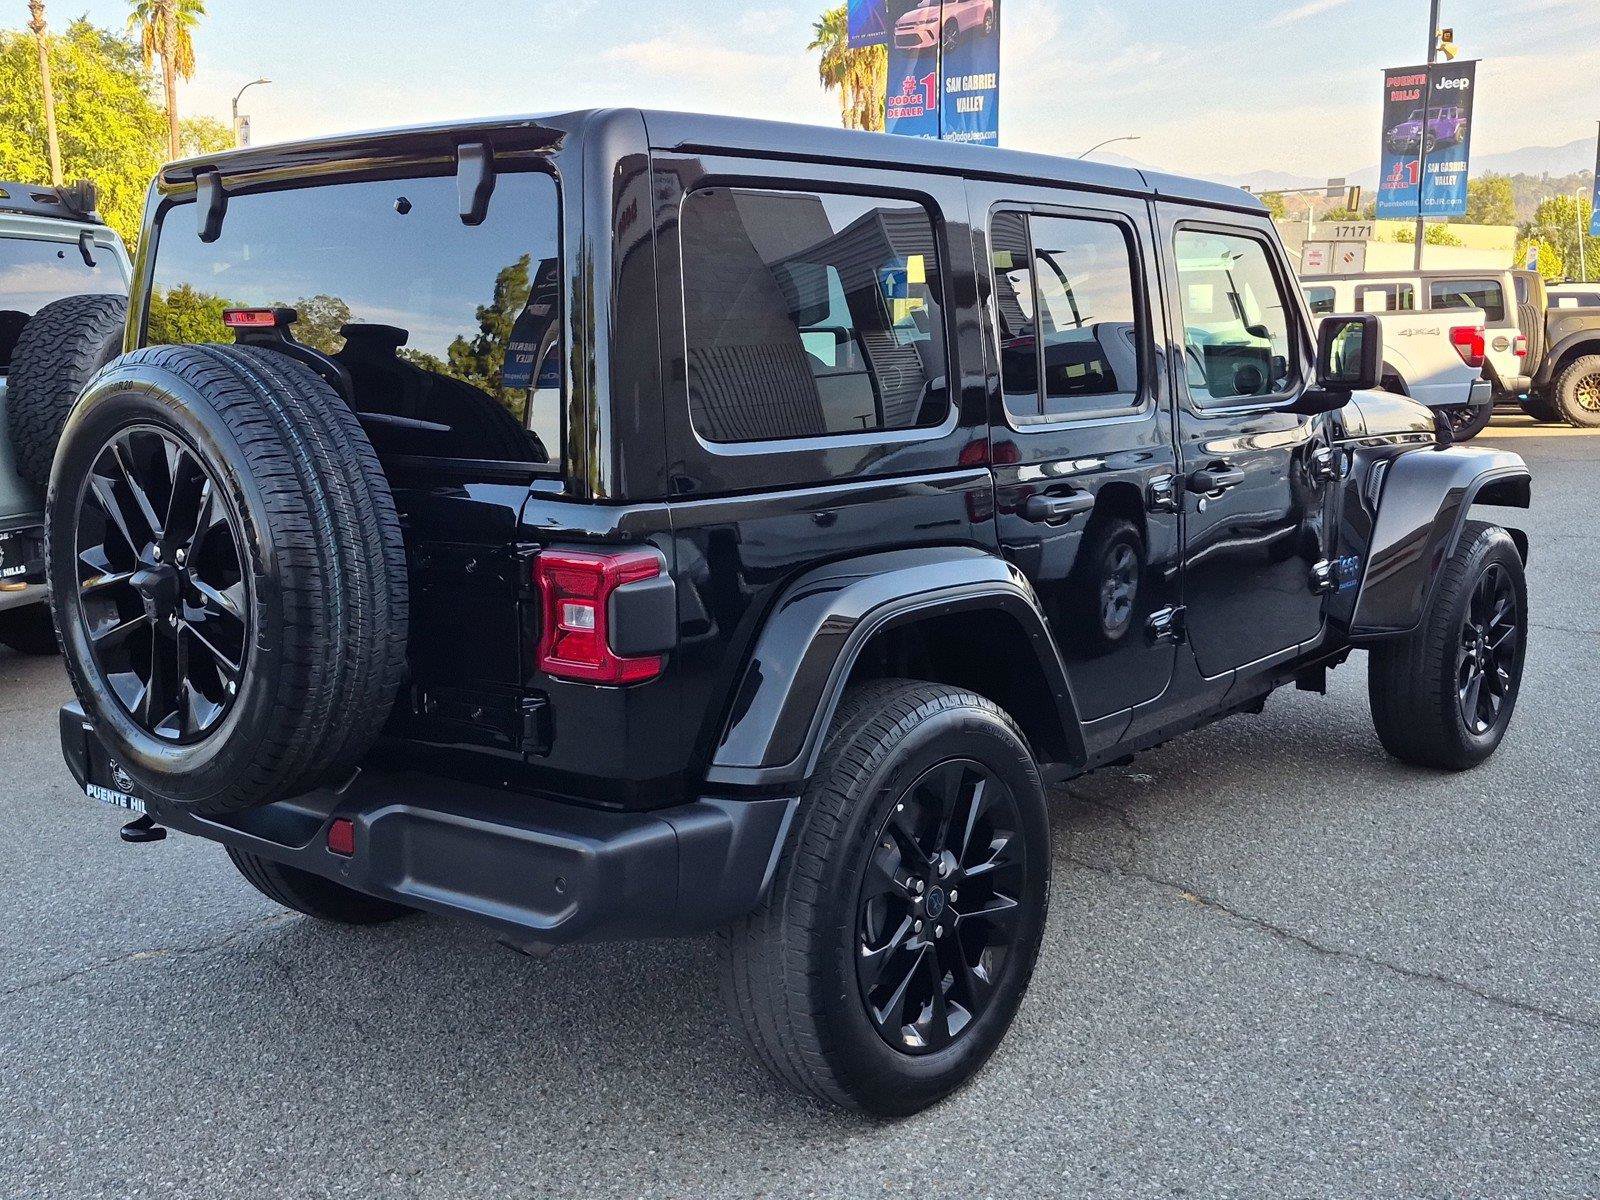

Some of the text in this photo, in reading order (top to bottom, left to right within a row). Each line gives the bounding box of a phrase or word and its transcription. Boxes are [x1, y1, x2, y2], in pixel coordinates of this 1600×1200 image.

[946, 73, 997, 93] SAN GABRIEL
[1386, 74, 1427, 88] PUENTE
[1435, 76, 1469, 91] Jeep
[889, 94, 922, 106] DODGE
[1391, 89, 1420, 101] HILLS
[956, 96, 984, 113] VALLEY
[887, 107, 923, 118] DEALER
[1427, 161, 1467, 173] SAN GABRIEL
[1434, 175, 1457, 186] VALLEY
[1335, 226, 1372, 237] 17171
[3, 565, 26, 577] HILLS
[86, 783, 127, 808] PUENTE
